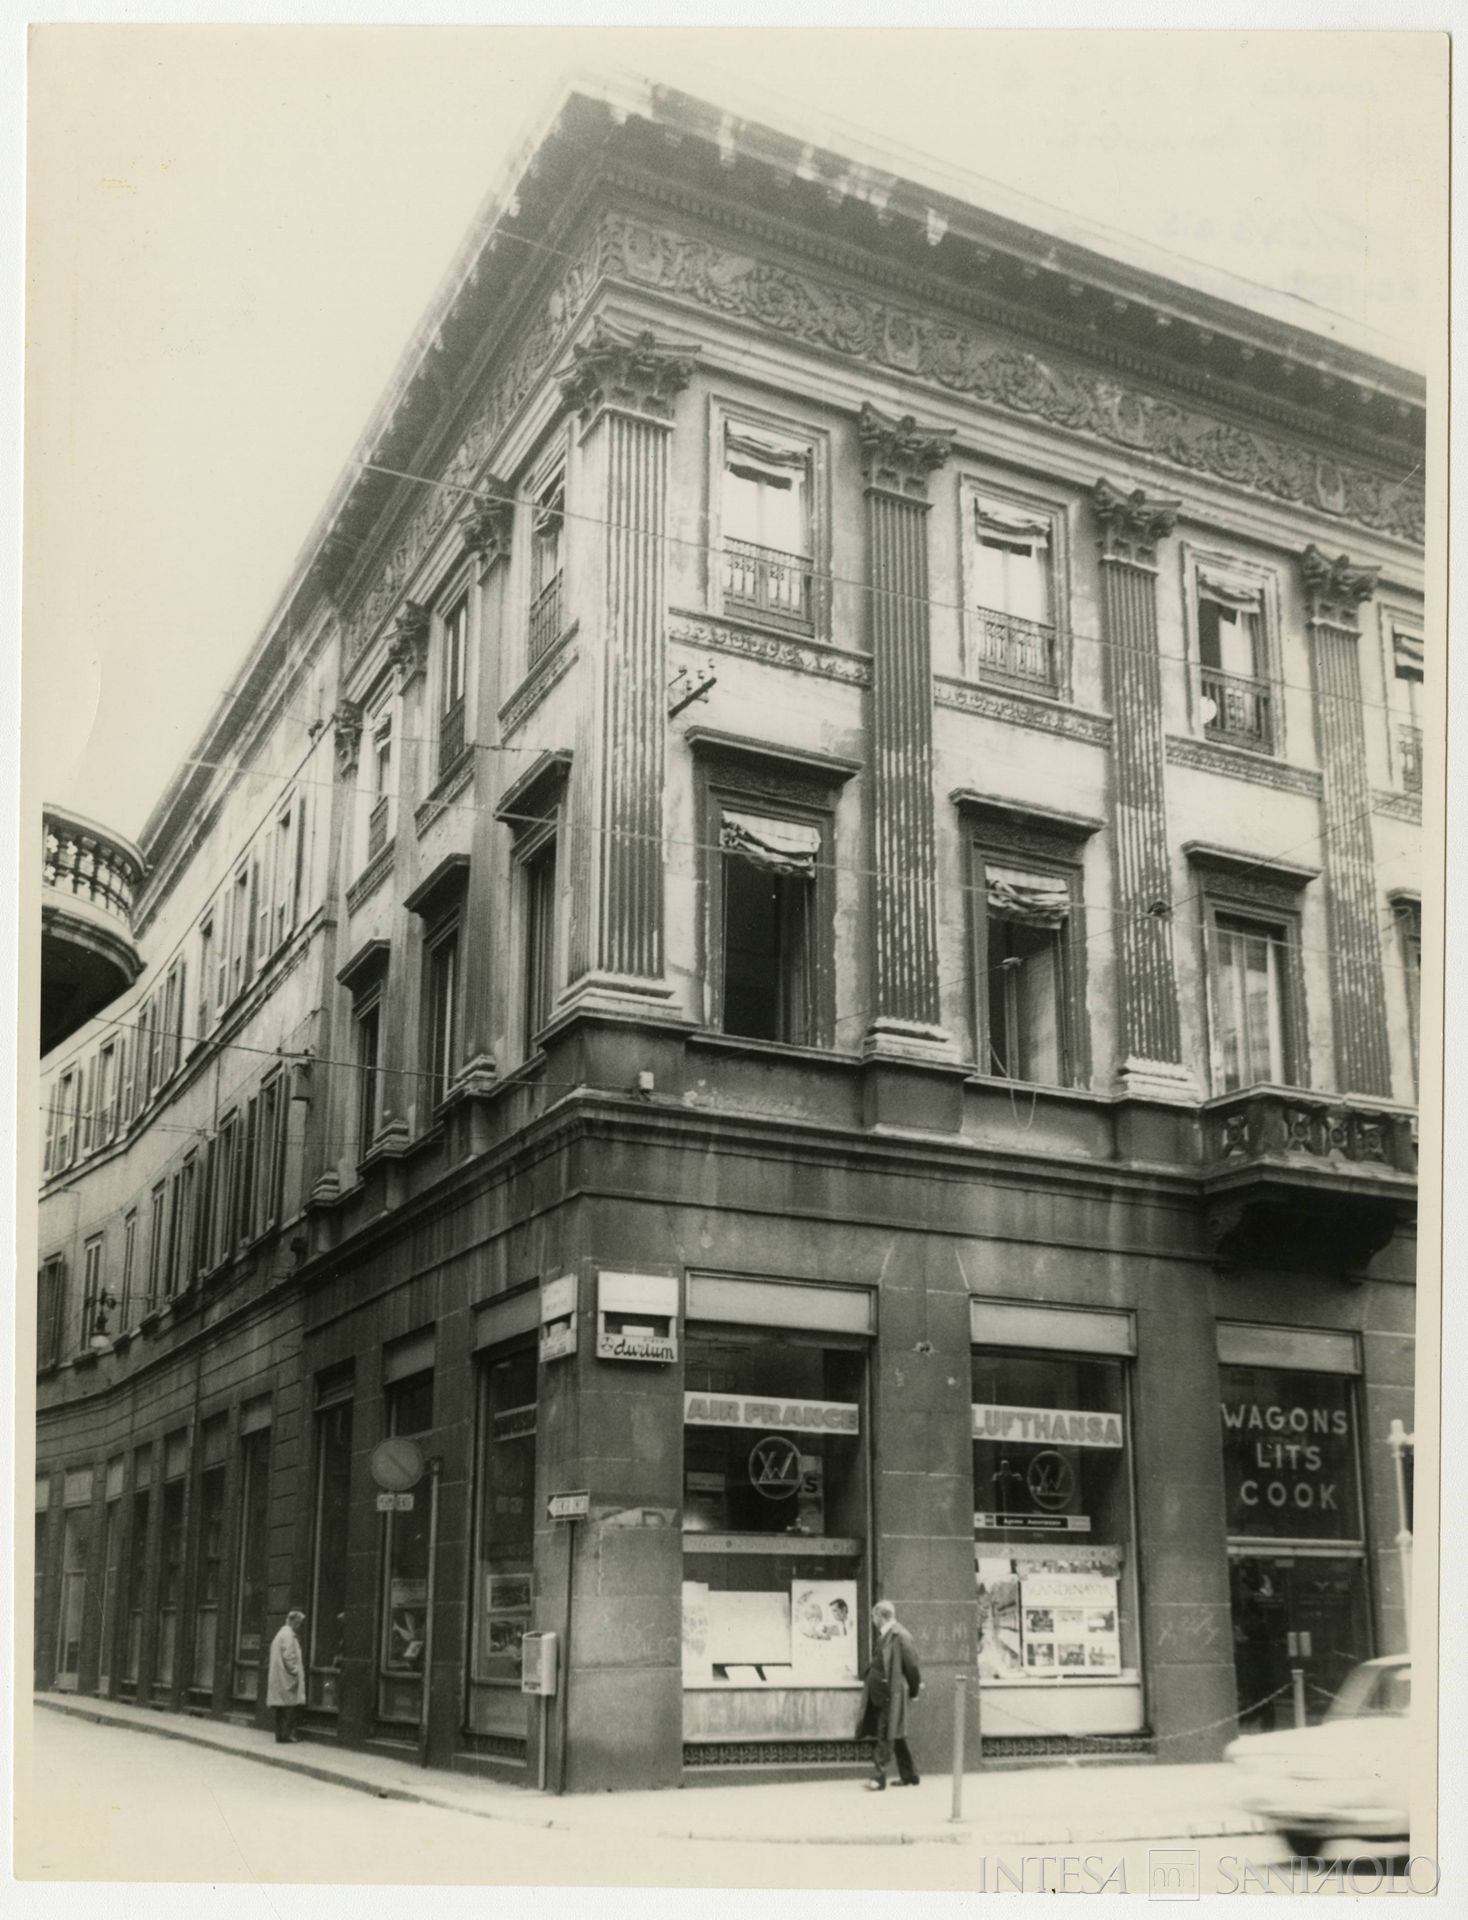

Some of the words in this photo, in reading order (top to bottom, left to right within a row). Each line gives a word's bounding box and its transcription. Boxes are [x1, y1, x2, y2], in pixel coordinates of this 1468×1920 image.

[613, 1336, 674, 1359] durium
[686, 1398, 740, 1423] AIR
[744, 1402, 858, 1431] FRANCE
[972, 1408, 1121, 1444] LUFTHANSA
[1220, 1402, 1348, 1434] WAGONS
[1256, 1442, 1322, 1471] LITS
[1240, 1480, 1338, 1510] COOK
